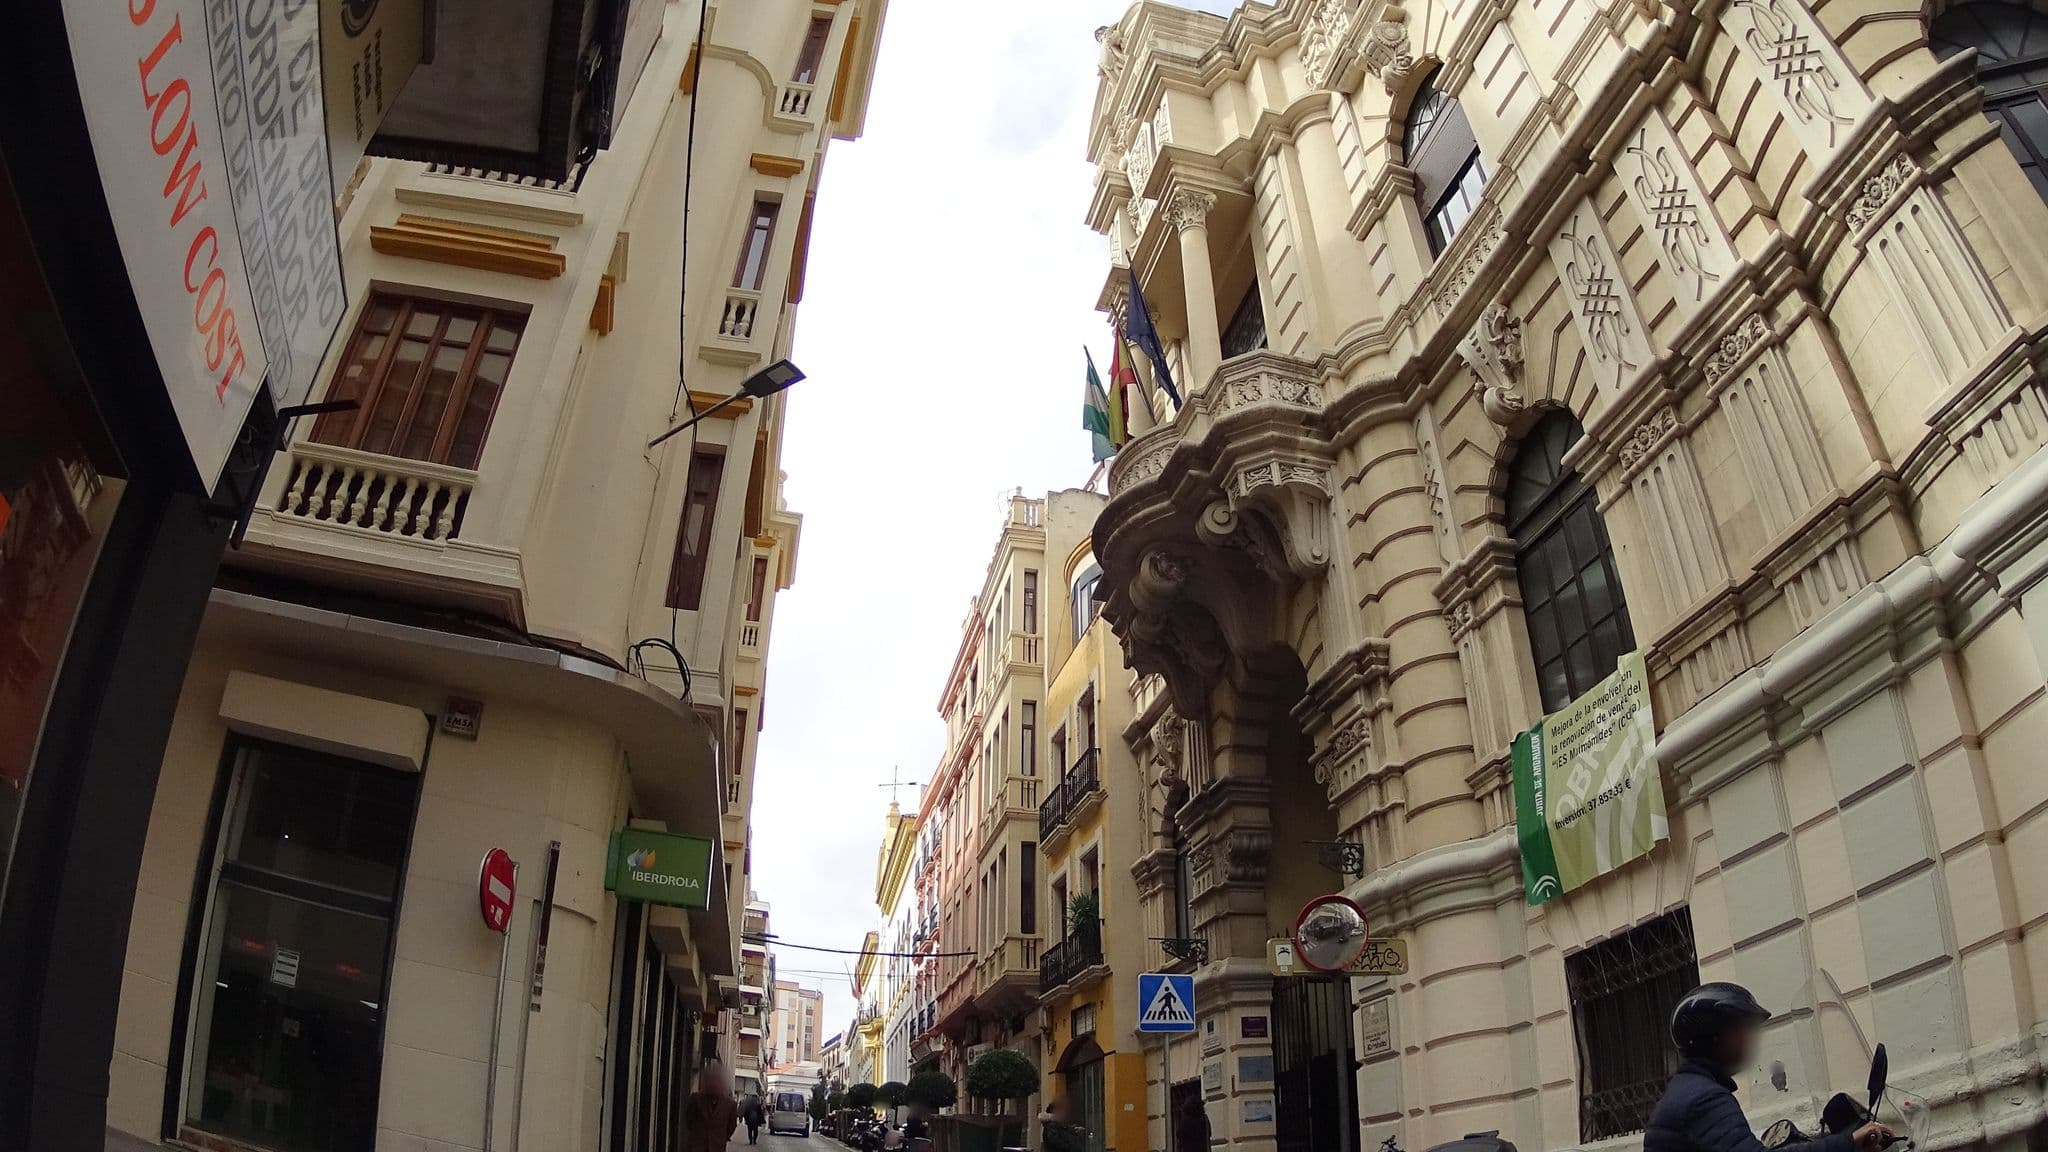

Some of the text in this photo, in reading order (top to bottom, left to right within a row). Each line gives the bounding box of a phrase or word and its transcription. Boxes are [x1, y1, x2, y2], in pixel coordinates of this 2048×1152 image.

[288, 34, 317, 137] DE
[138, 12, 208, 228] LOW
[184, 226, 246, 408] COST
[229, 136, 254, 206] DE
[243, 218, 288, 385] AUTOCAD
[1551, 744, 1558, 756] la
[1559, 719, 1596, 749] renovación
[1596, 712, 1606, 724] de
[1627, 680, 1641, 698] del
[1551, 719, 1573, 738] Mejora
[1574, 709, 1583, 722] de
[1584, 704, 1591, 716] la
[1535, 791, 1543, 816] JUNTA
[1624, 777, 1632, 790] €
[632, 871, 699, 889] IBERDROLA
